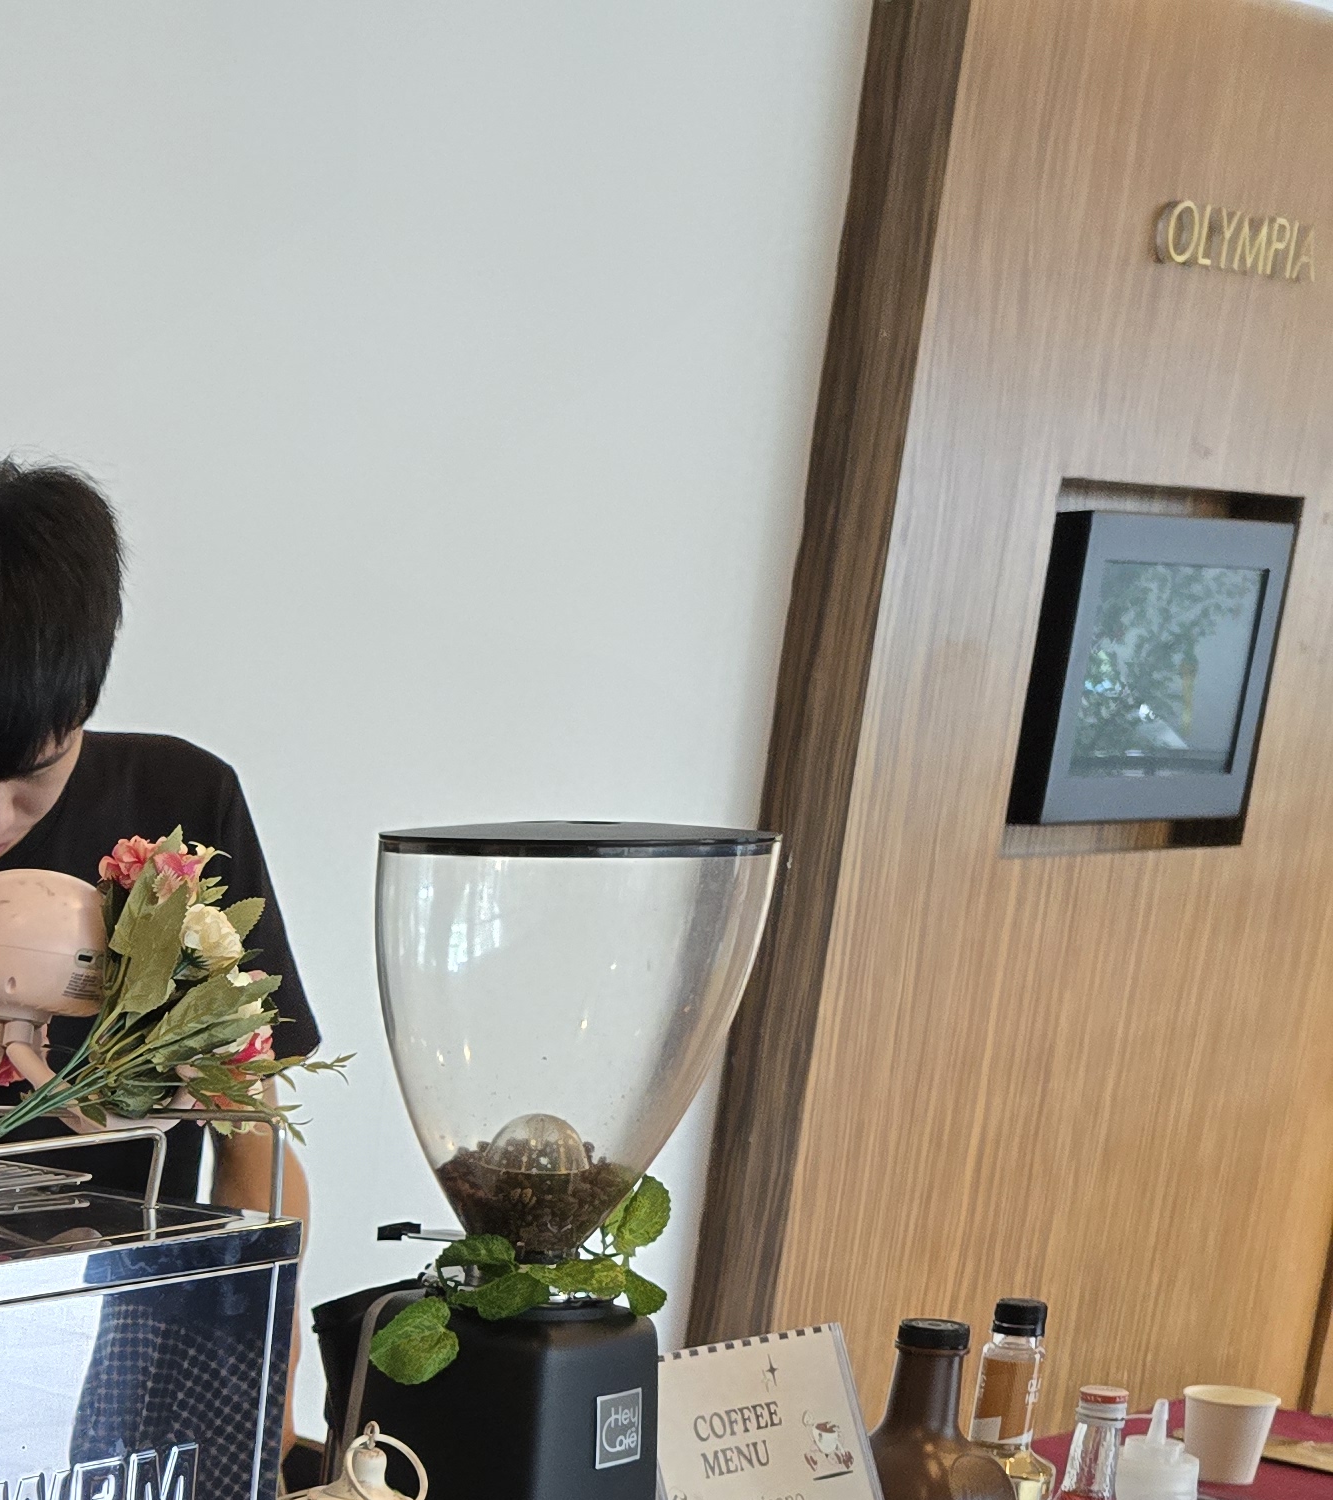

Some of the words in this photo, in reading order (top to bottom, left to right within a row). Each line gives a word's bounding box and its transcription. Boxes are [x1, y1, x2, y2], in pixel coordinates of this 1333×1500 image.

[1168, 200, 1315, 282] OLYMPIA
[610, 1405, 639, 1428] Hey
[693, 1401, 782, 1442] COFFEE
[701, 1440, 770, 1479] MENU
